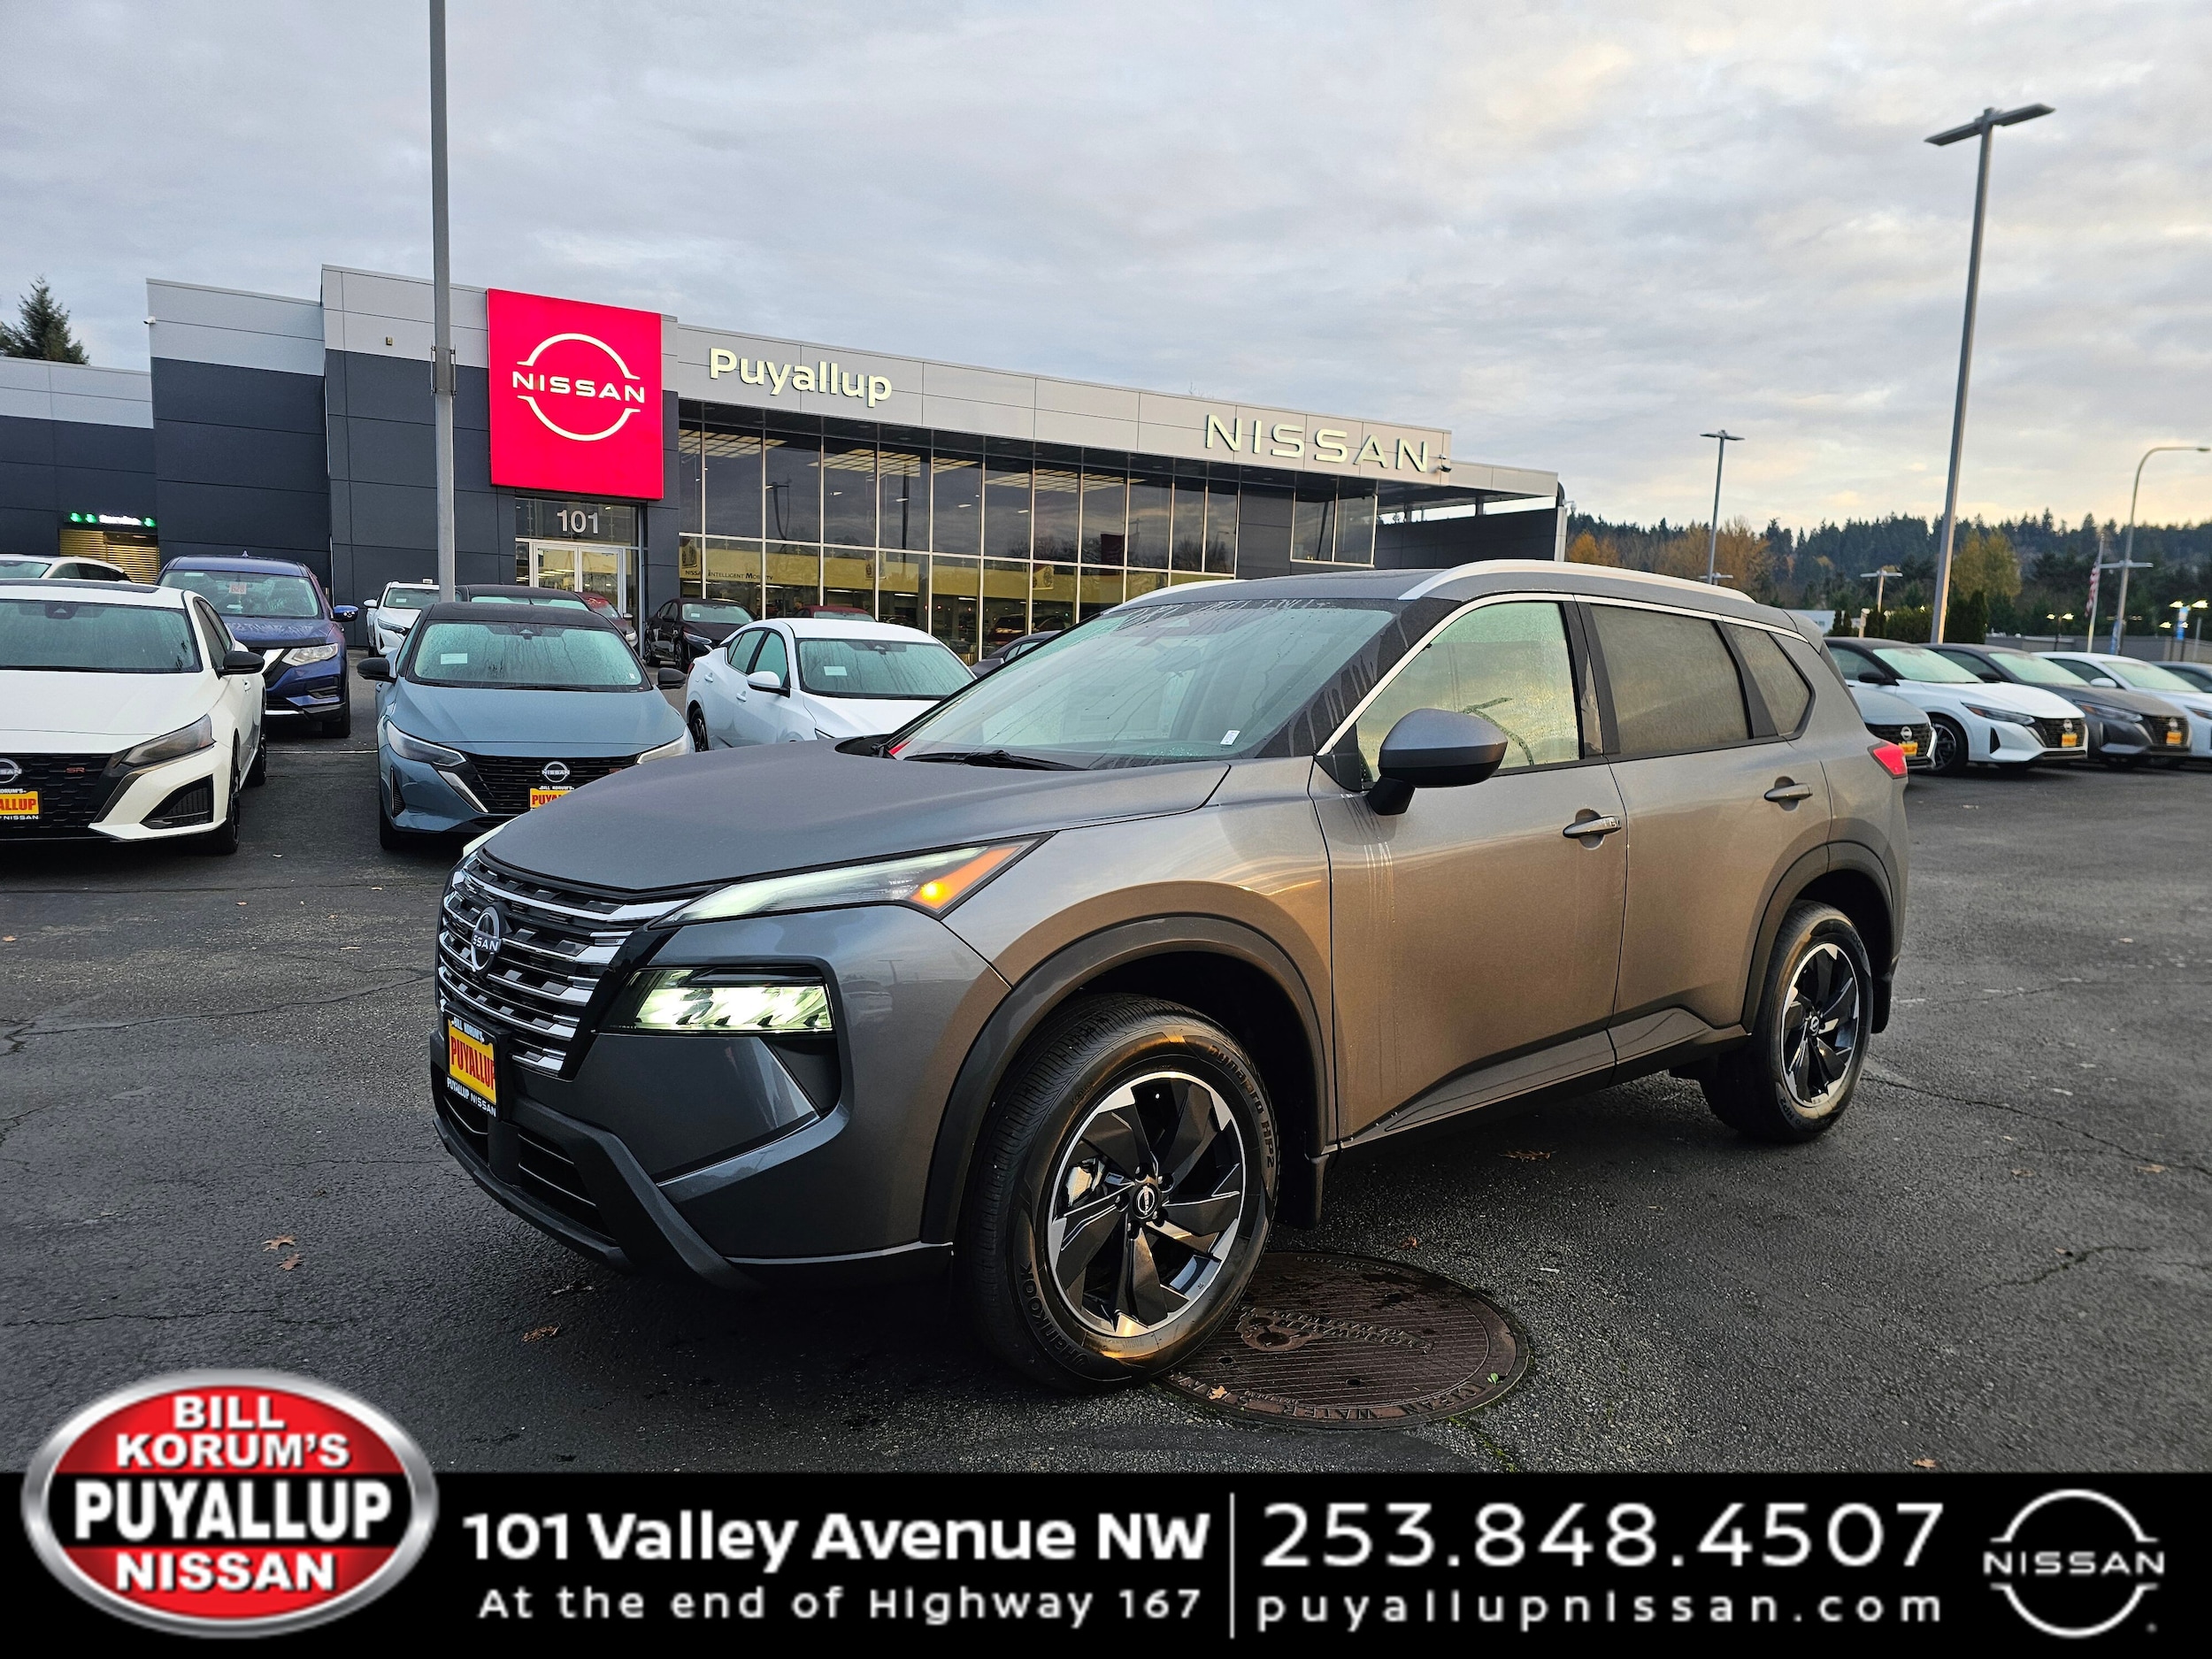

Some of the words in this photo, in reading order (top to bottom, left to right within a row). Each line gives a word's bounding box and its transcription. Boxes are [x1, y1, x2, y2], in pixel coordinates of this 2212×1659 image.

[512, 371, 645, 403] NISSAN
[710, 347, 893, 408] Puyallup
[1206, 414, 1429, 472] NISSAN
[557, 509, 599, 534] 101
[470, 1093, 496, 1118] NISSAN
[1261, 1120, 1276, 1169] HP2
